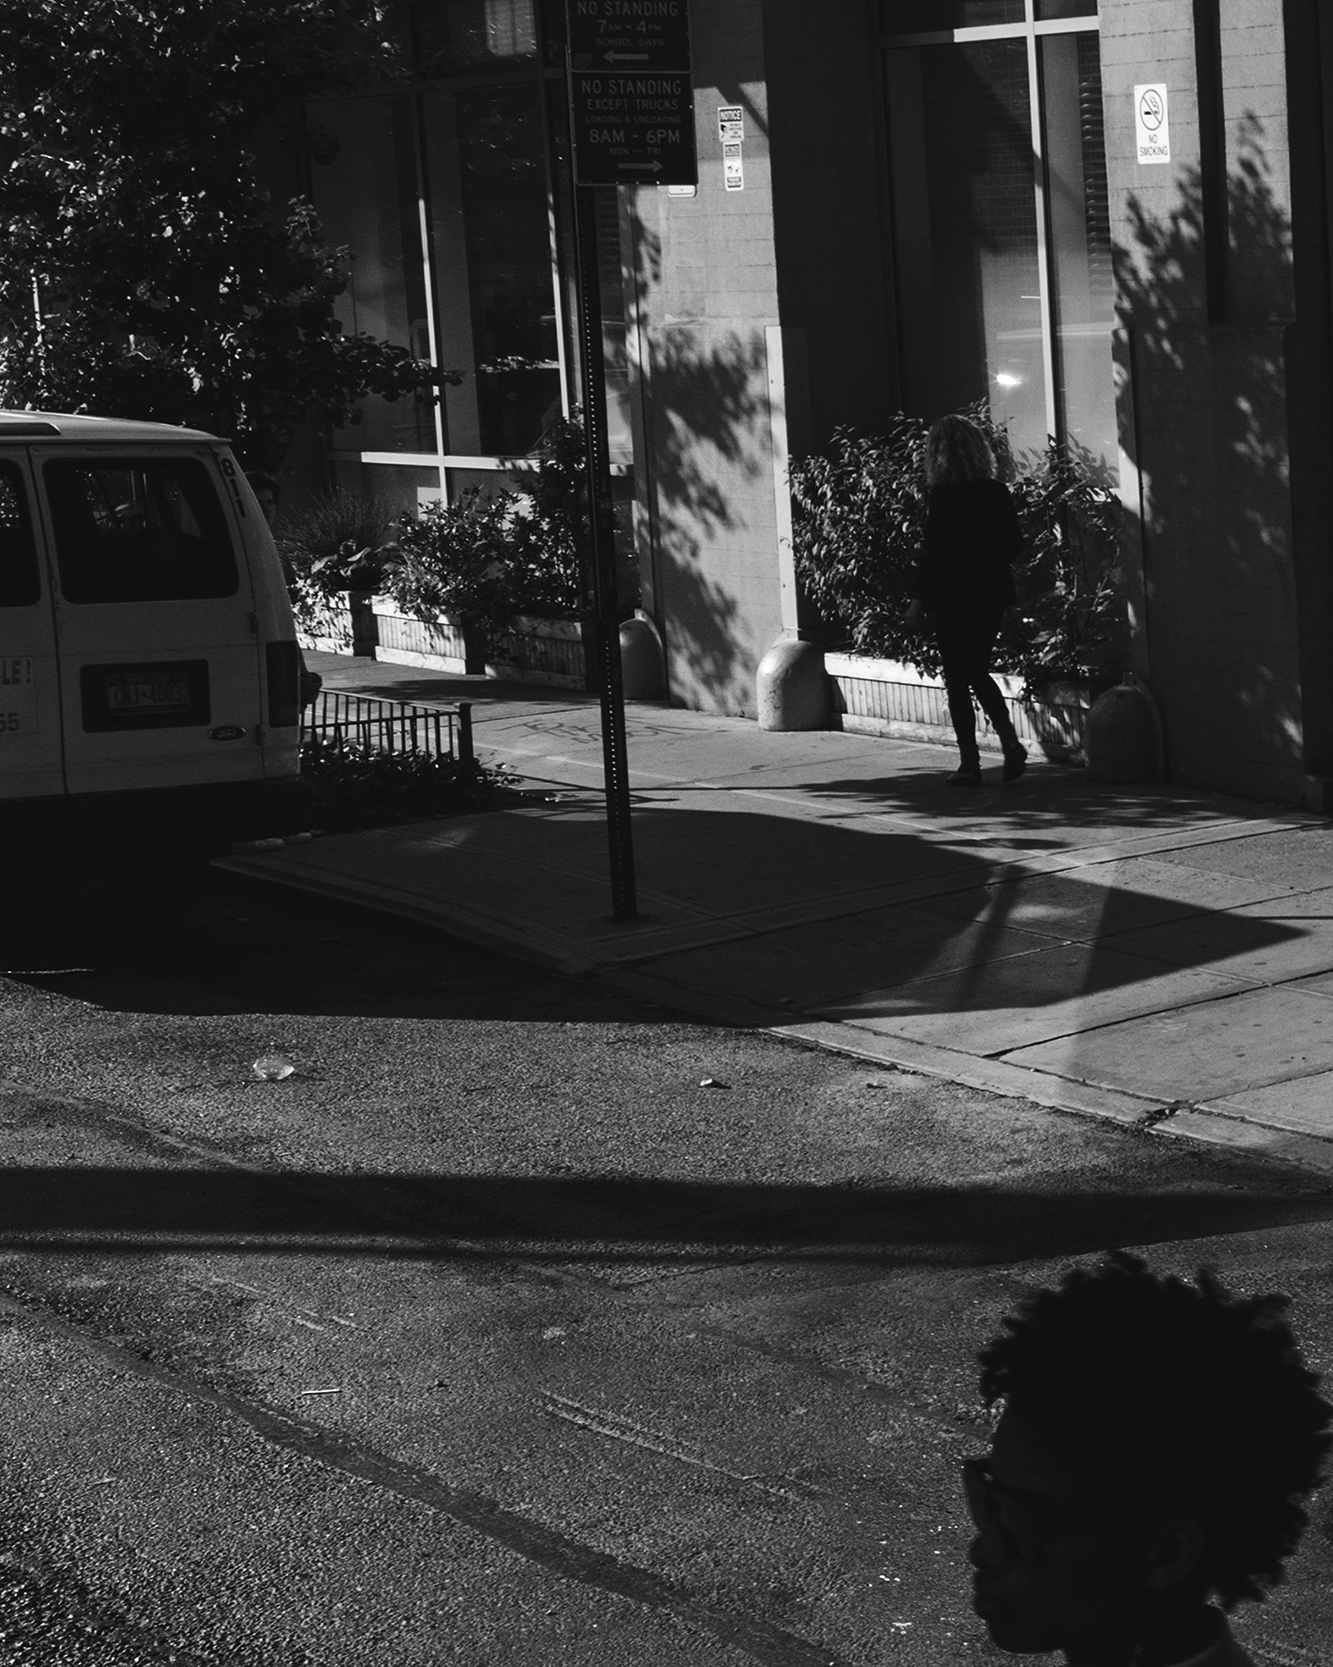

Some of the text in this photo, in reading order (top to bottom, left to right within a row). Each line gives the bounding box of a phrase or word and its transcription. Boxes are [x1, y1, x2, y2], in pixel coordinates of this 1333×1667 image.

[577, 1, 679, 16] NO STANDING
[596, 19, 622, 34] 7AM
[636, 19, 662, 34] 4PM
[595, 37, 665, 46] SCHOOL DAYS
[582, 79, 682, 95] NO STANDING
[587, 98, 679, 110] EXCEPT TRUCKS
[585, 115, 622, 124] LOADING
[634, 115, 682, 124] UNLOADING
[589, 129, 625, 144] 8AM
[646, 129, 680, 144] 6PM
[1148, 134, 1158, 144] NO
[609, 147, 629, 156] MON
[647, 147, 662, 156] FRI
[1139, 145, 1168, 157] SMOKING
[221, 458, 247, 518] 811
